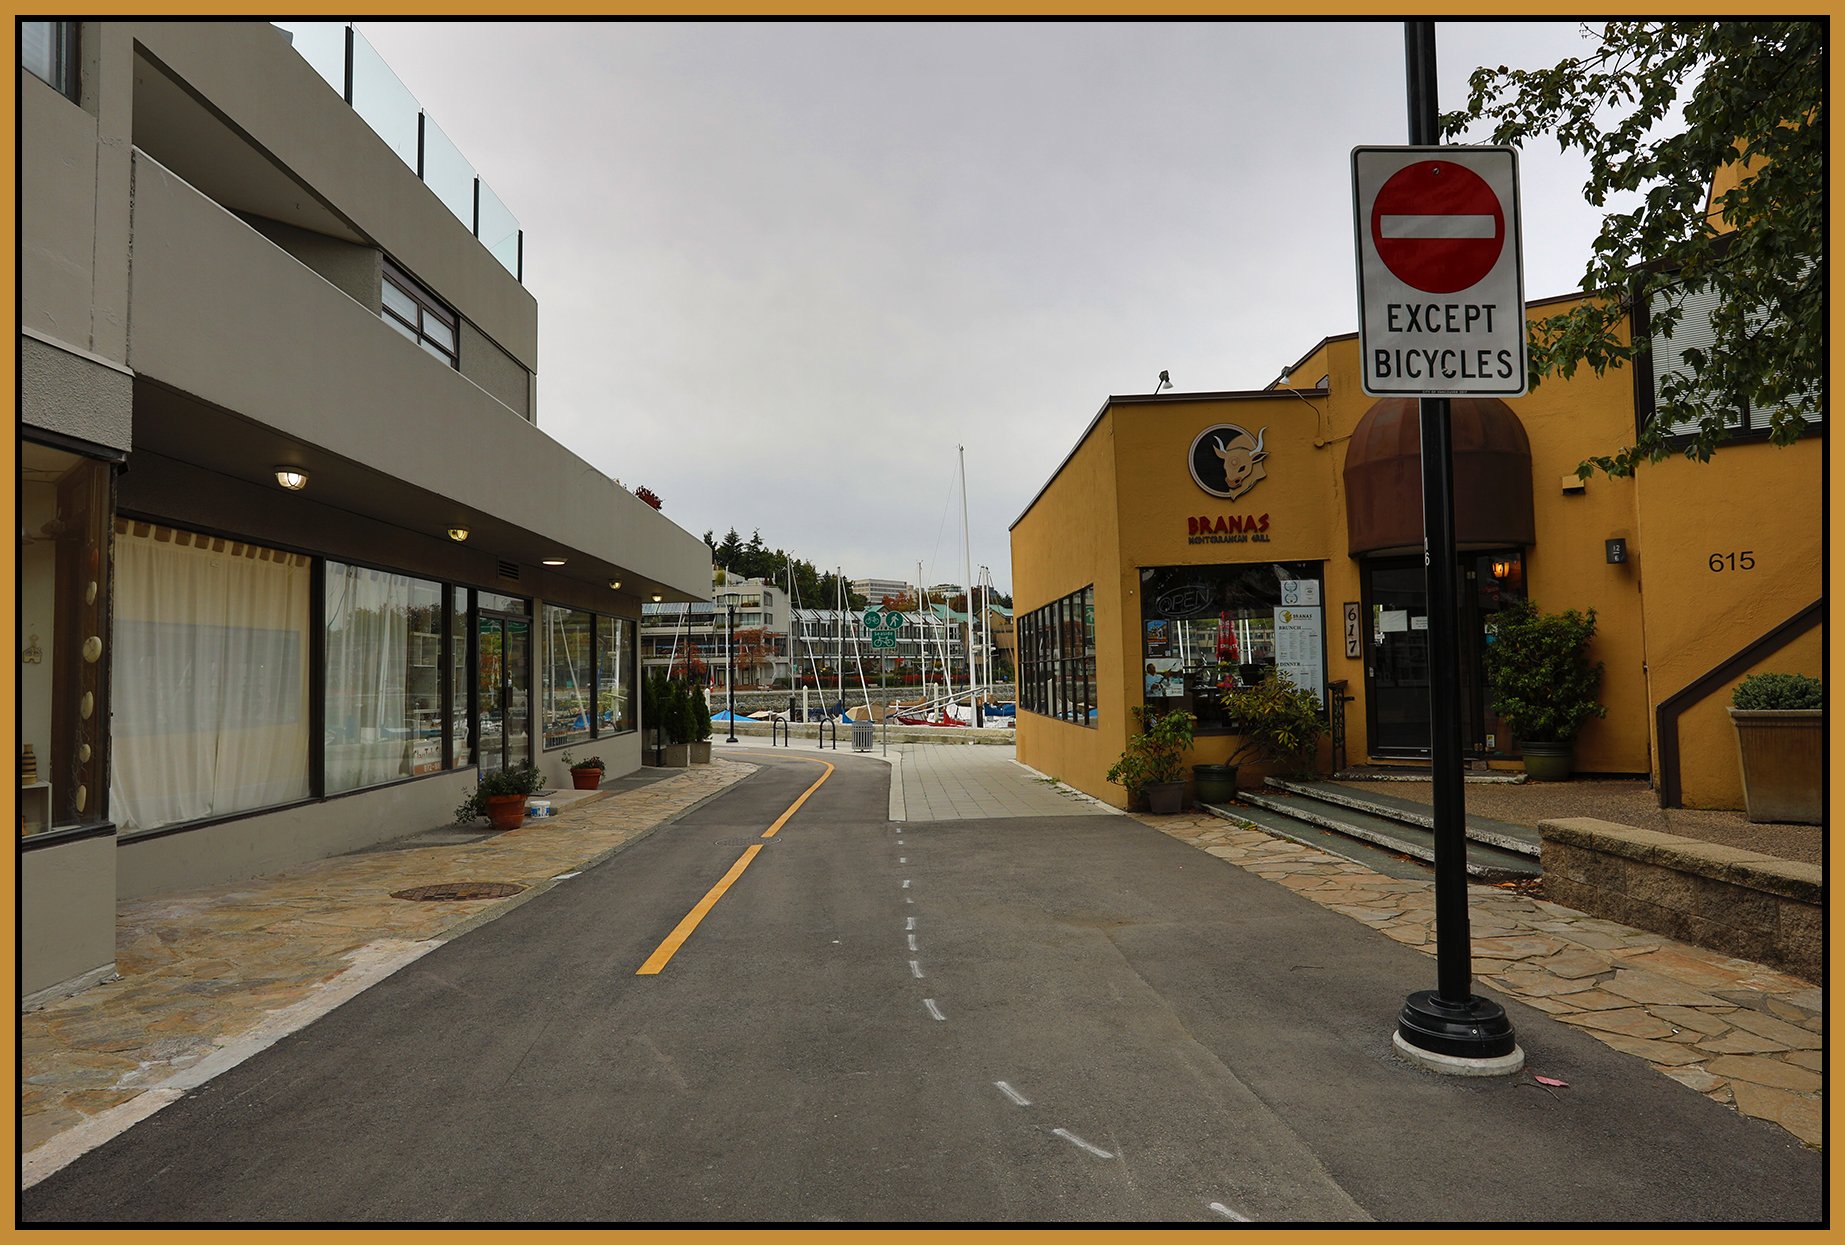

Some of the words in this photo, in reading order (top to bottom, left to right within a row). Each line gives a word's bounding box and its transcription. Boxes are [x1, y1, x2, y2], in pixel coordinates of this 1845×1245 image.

[1387, 304, 1497, 333] EXCEPT
[1375, 349, 1513, 379] BICYCLES
[1187, 513, 1270, 535] BRANAS
[1188, 535, 1248, 545] MEDITERRANEAN
[1251, 534, 1271, 543] GRILL
[1708, 551, 1756, 573] 615
[1158, 588, 1210, 613] OPEN
[1347, 607, 1357, 653] 617
